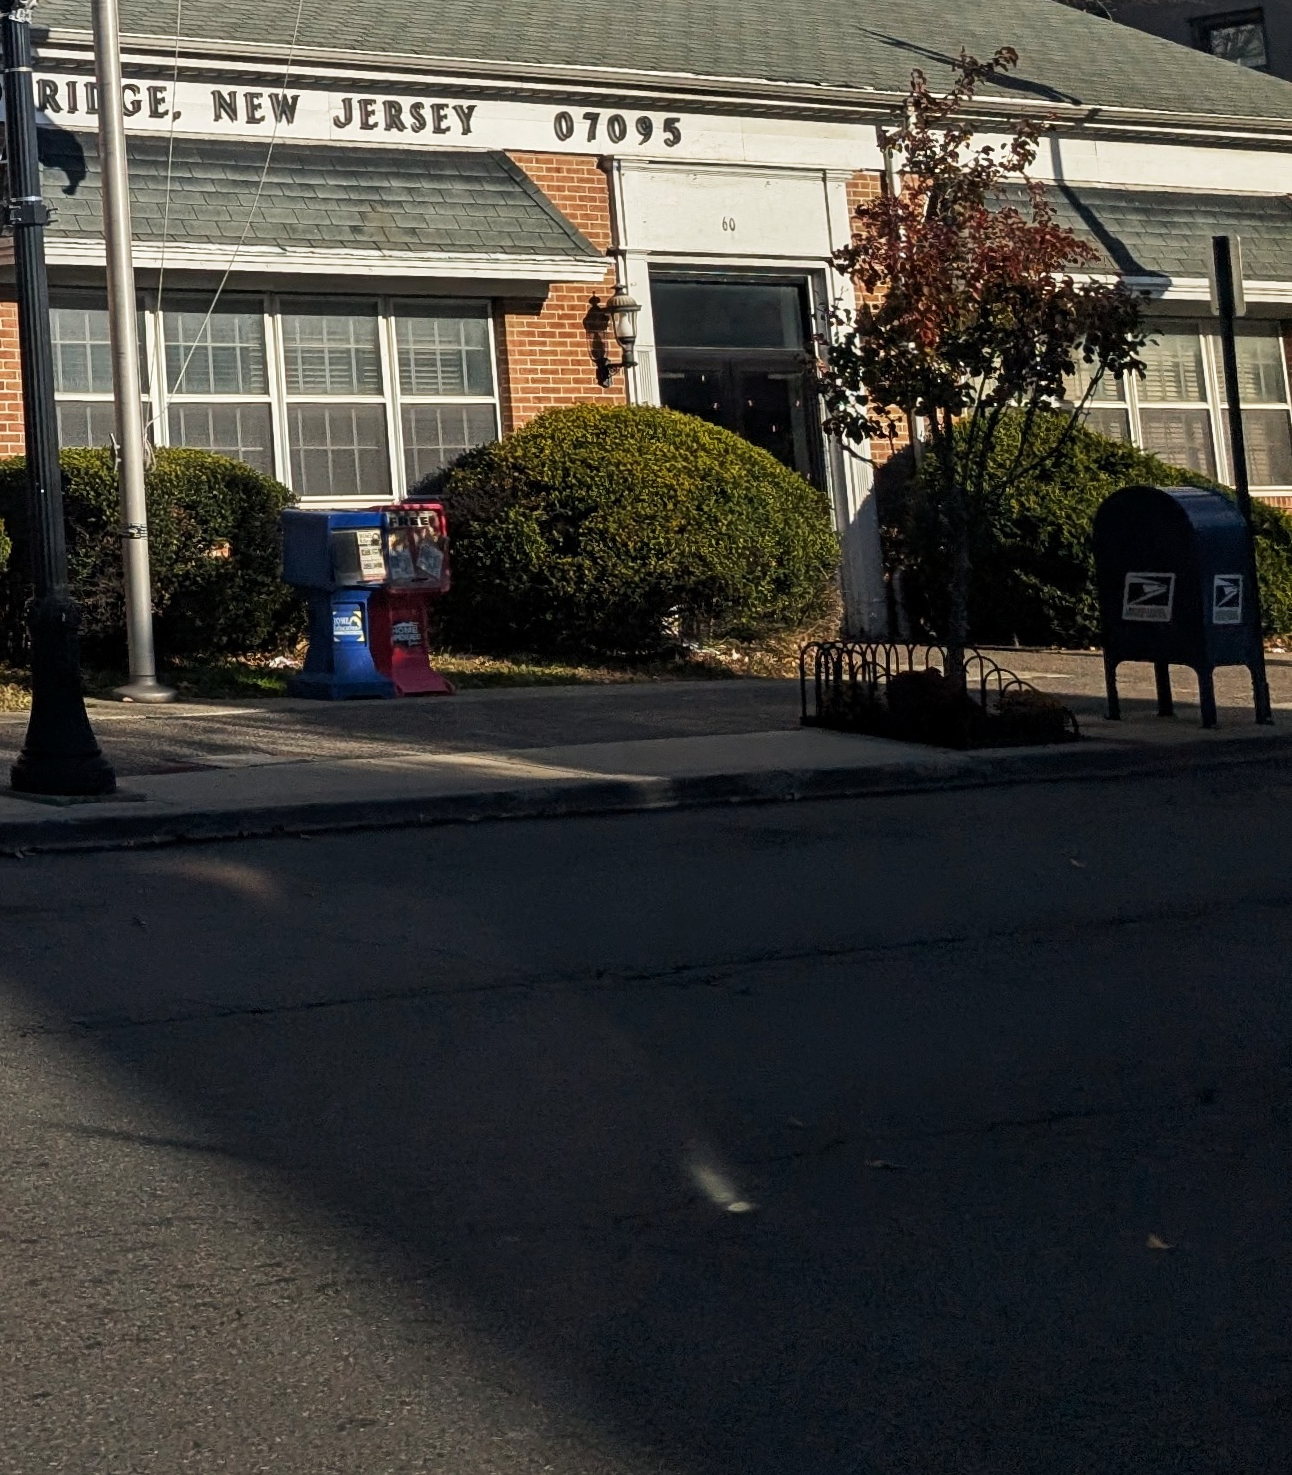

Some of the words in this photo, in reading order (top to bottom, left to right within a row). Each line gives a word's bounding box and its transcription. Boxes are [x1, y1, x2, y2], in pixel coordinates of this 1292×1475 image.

[210, 89, 301, 125] NEW
[332, 97, 478, 136] JERSEY
[553, 110, 682, 148] 07095
[722, 216, 736, 232] 60
[389, 516, 429, 527] FREE
